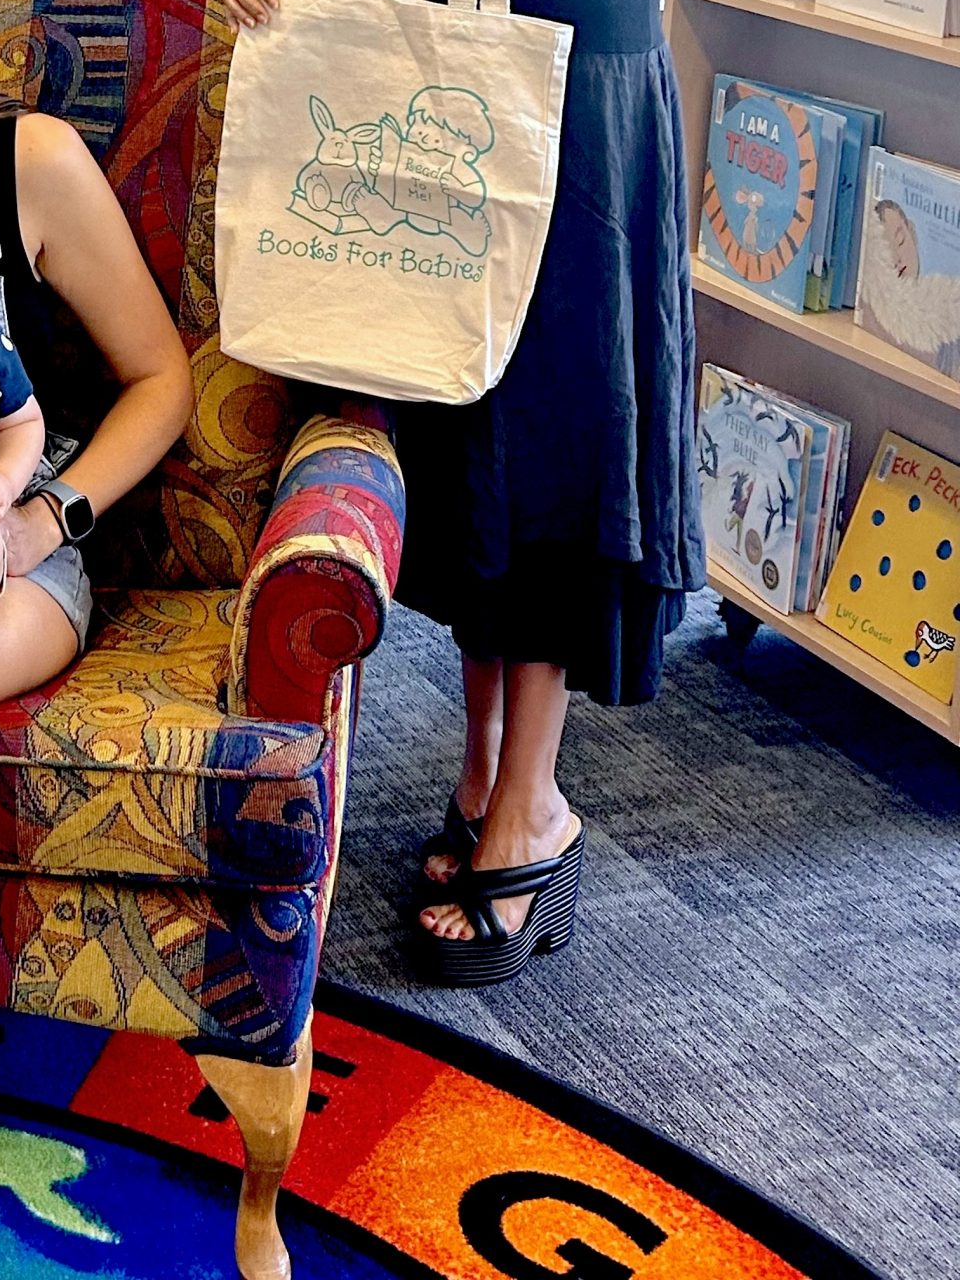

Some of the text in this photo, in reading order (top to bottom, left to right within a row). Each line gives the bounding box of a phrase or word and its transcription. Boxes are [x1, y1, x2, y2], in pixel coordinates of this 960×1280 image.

[739, 112, 780, 143] I AM A
[405, 157, 441, 179] Read
[725, 129, 788, 189] TIGER
[411, 177, 427, 190] To
[257, 229, 485, 282] Books For Babies
[724, 413, 770, 453] THEY SAY
[733, 438, 759, 466] BLUE
[891, 456, 921, 481] ECK,
[835, 603, 893, 645] Lucy Cousins
[458, 1170, 669, 1280] G
